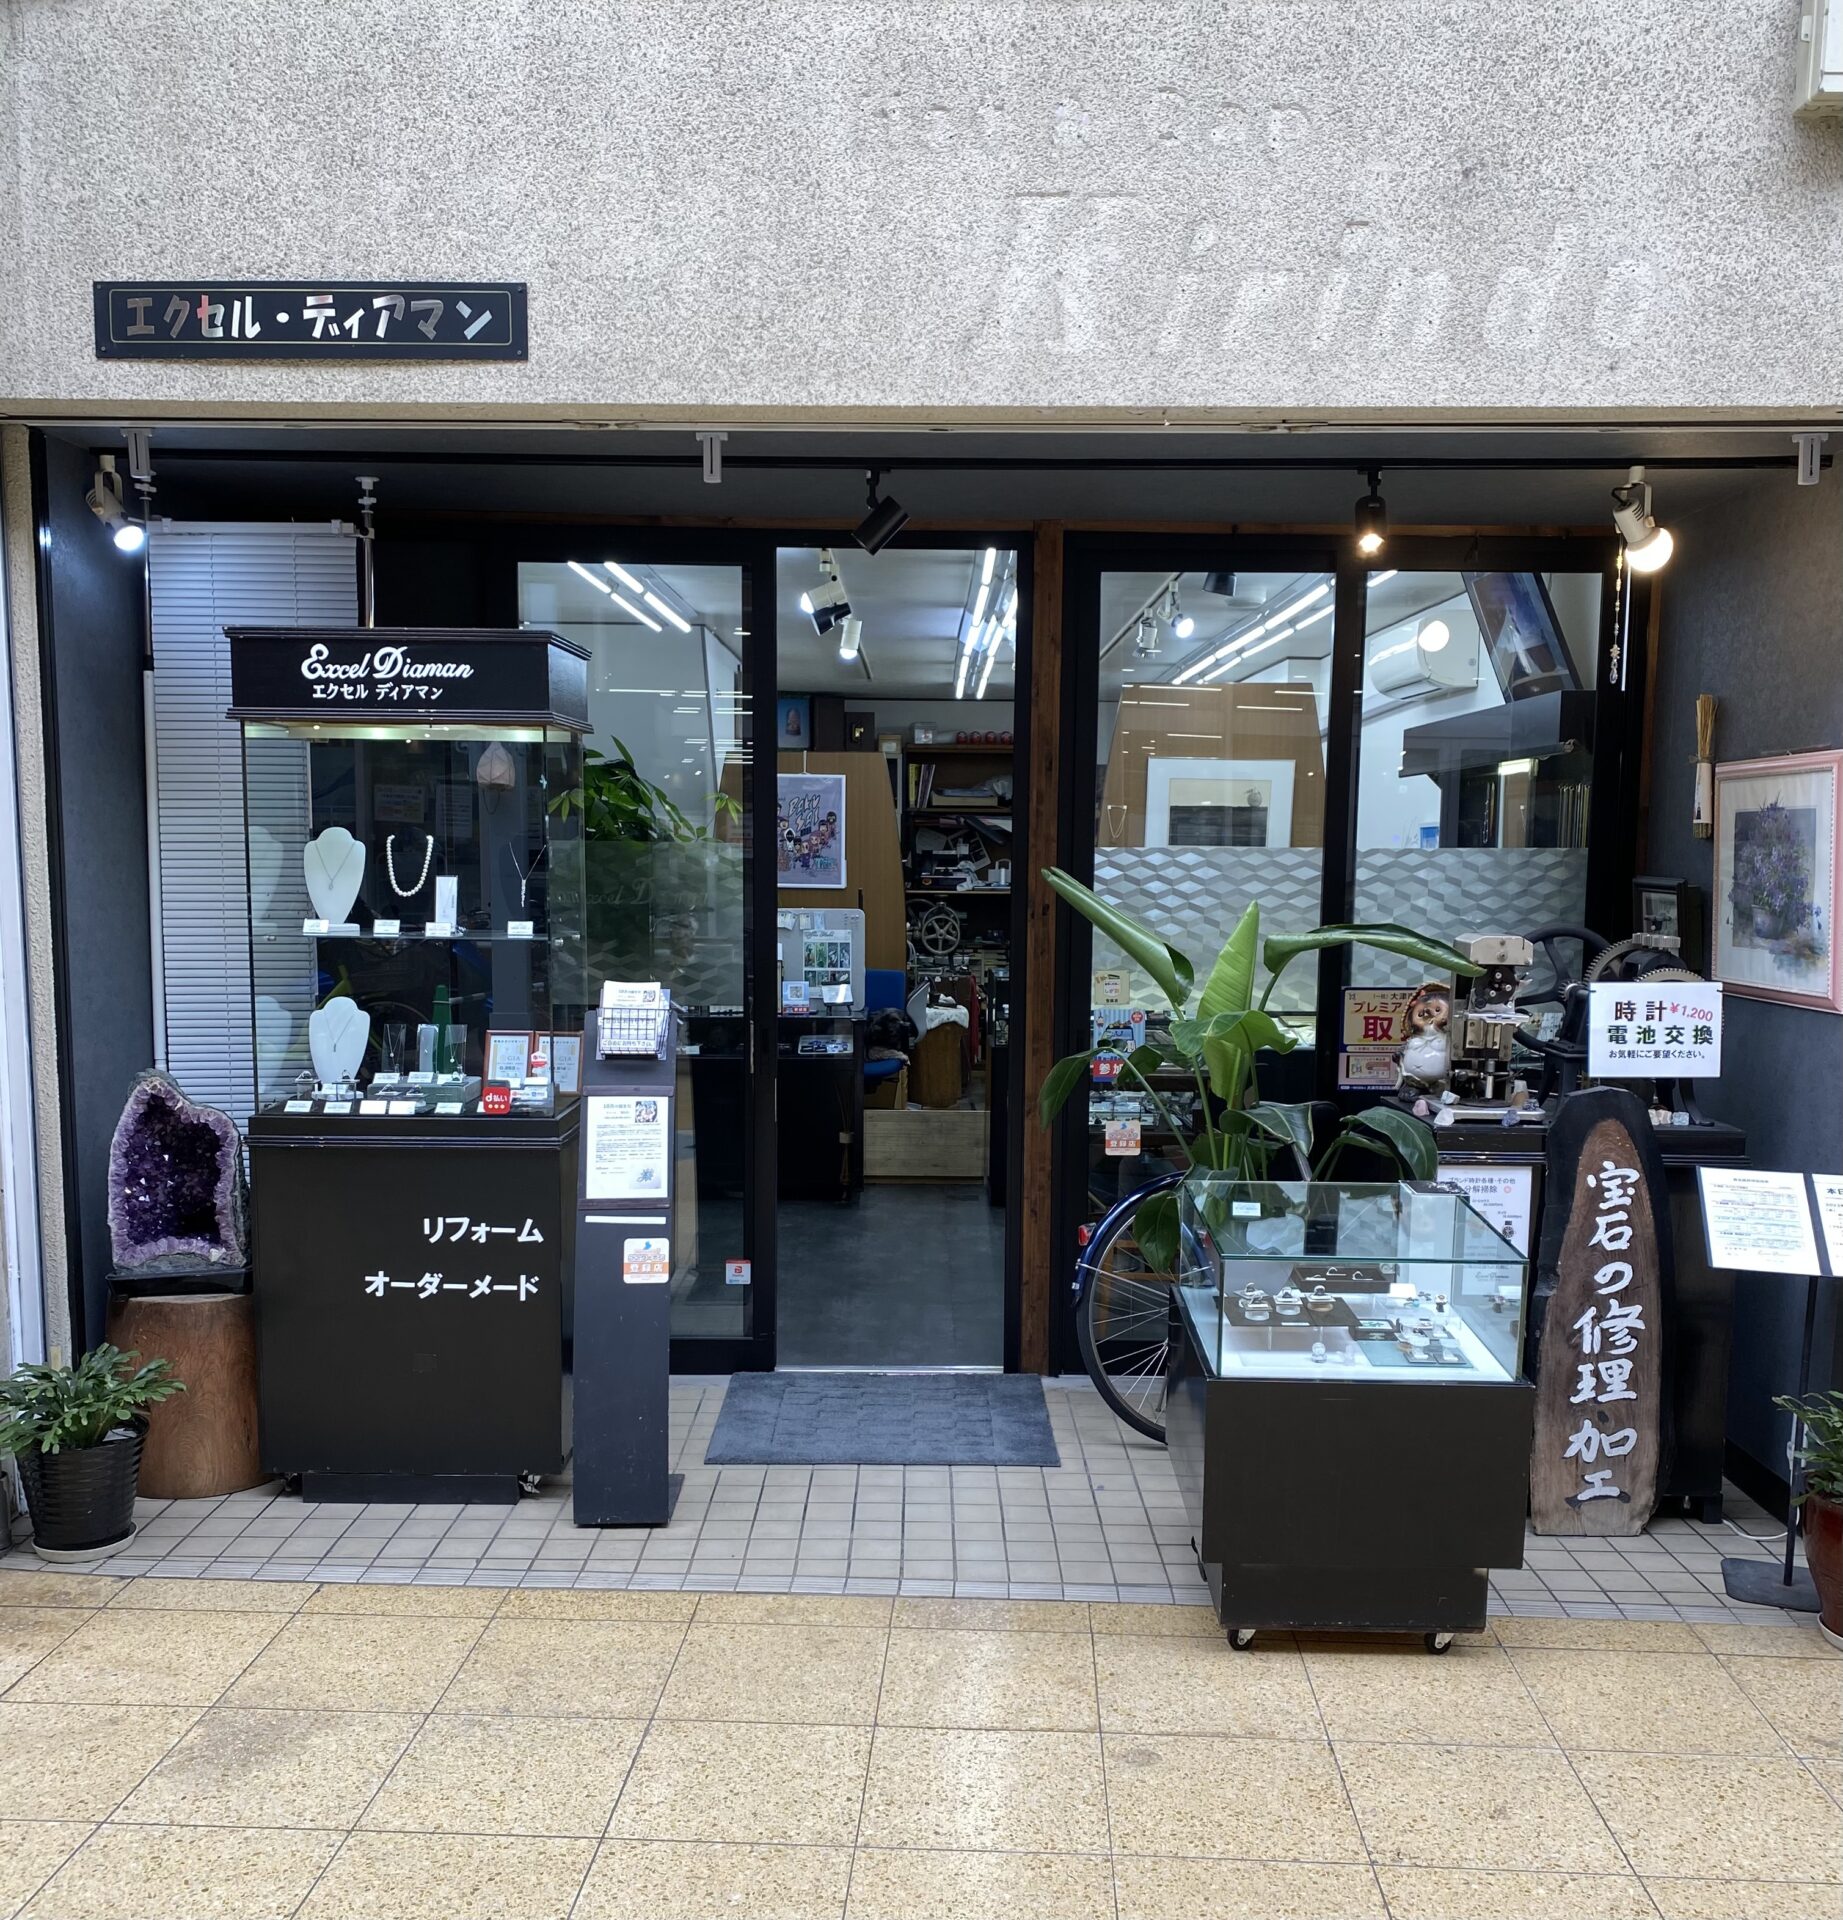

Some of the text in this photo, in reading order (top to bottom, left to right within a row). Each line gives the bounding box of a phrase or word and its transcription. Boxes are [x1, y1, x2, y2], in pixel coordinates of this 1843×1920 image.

[126, 294, 493, 341] エクセル・ディアマン
[301, 643, 475, 680] Excel Diaman
[312, 682, 443, 700] エクセル ディアマン
[1614, 1001, 1667, 1021] 時計
[1363, 1015, 1407, 1041] 取
[1607, 1025, 1713, 1045] 電池交換
[422, 1217, 544, 1244] リフォーム
[364, 1271, 539, 1302] オーダーメード
[1563, 1160, 1646, 1501] 宝石の修理加工
